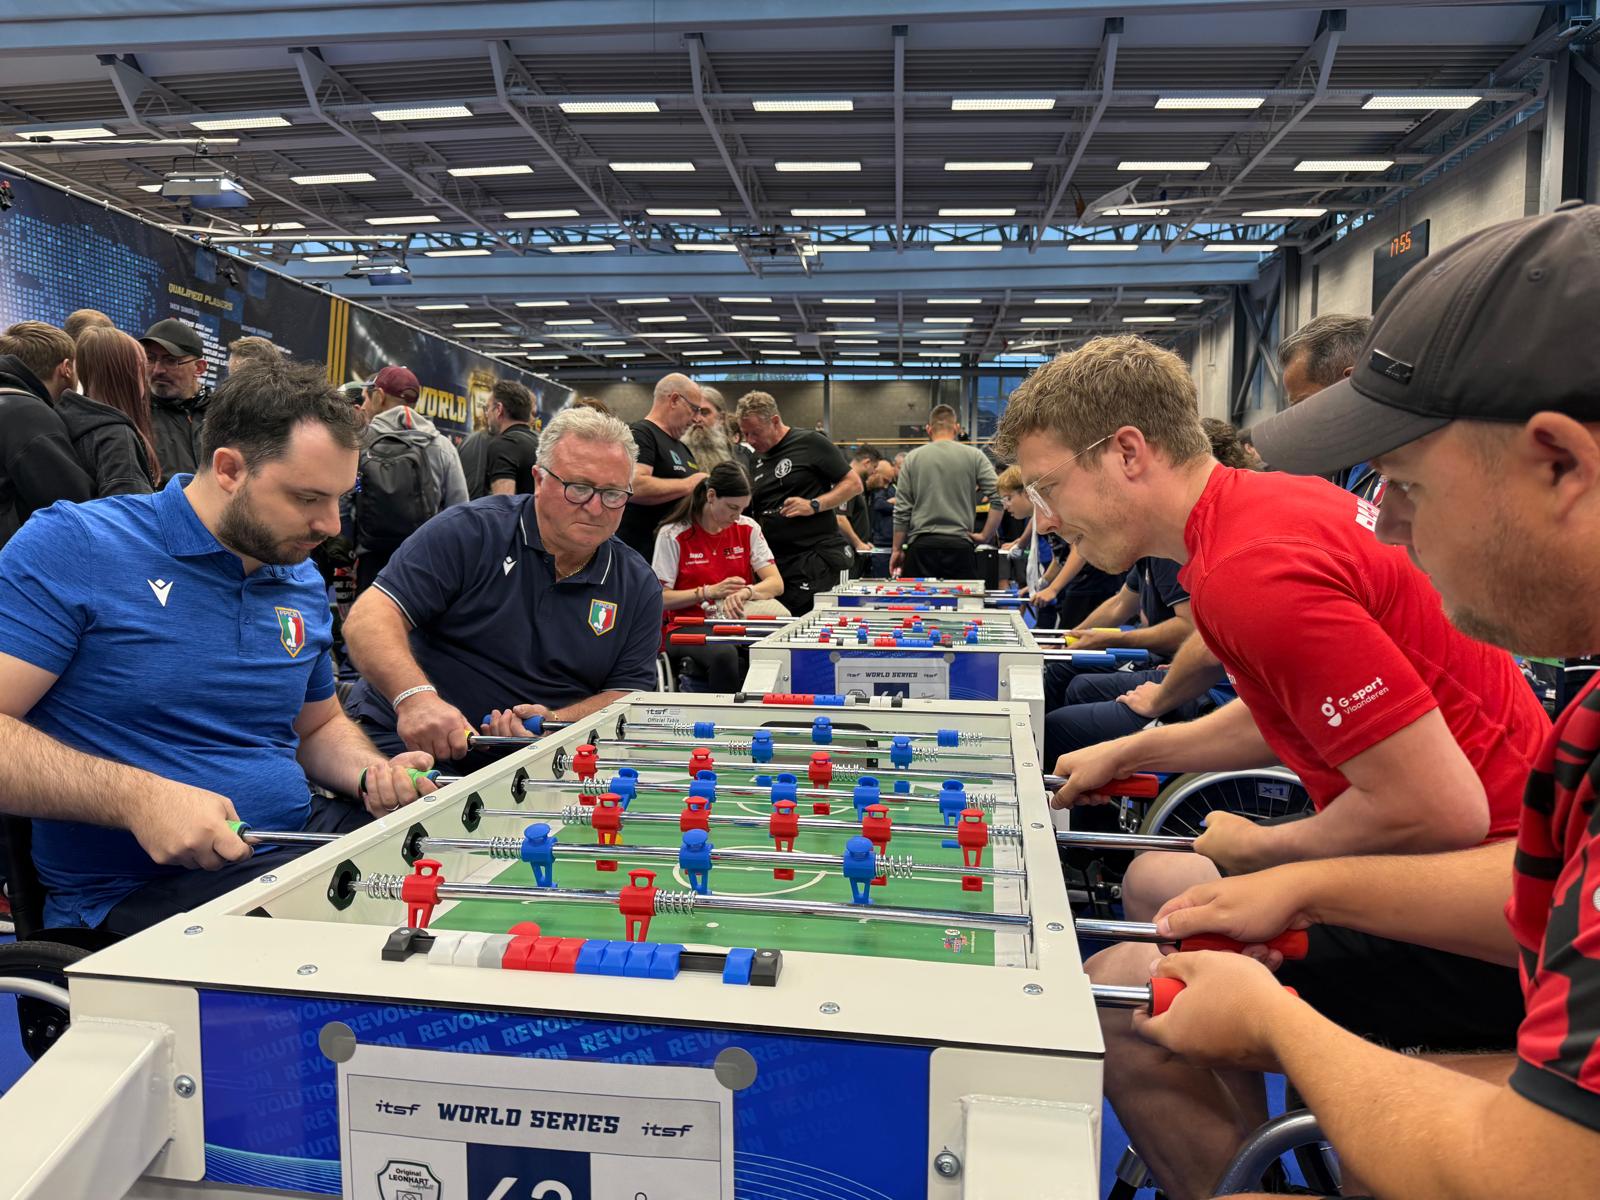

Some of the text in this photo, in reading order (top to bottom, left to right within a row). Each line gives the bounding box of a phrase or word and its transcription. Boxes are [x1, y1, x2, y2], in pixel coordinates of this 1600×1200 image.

[1344, 687, 1389, 714] Vlaanderen
[375, 1099, 693, 1138] itsf WORLD SERIES itsf
[388, 1174, 430, 1185] LEONHART
[395, 1168, 422, 1177] Original
